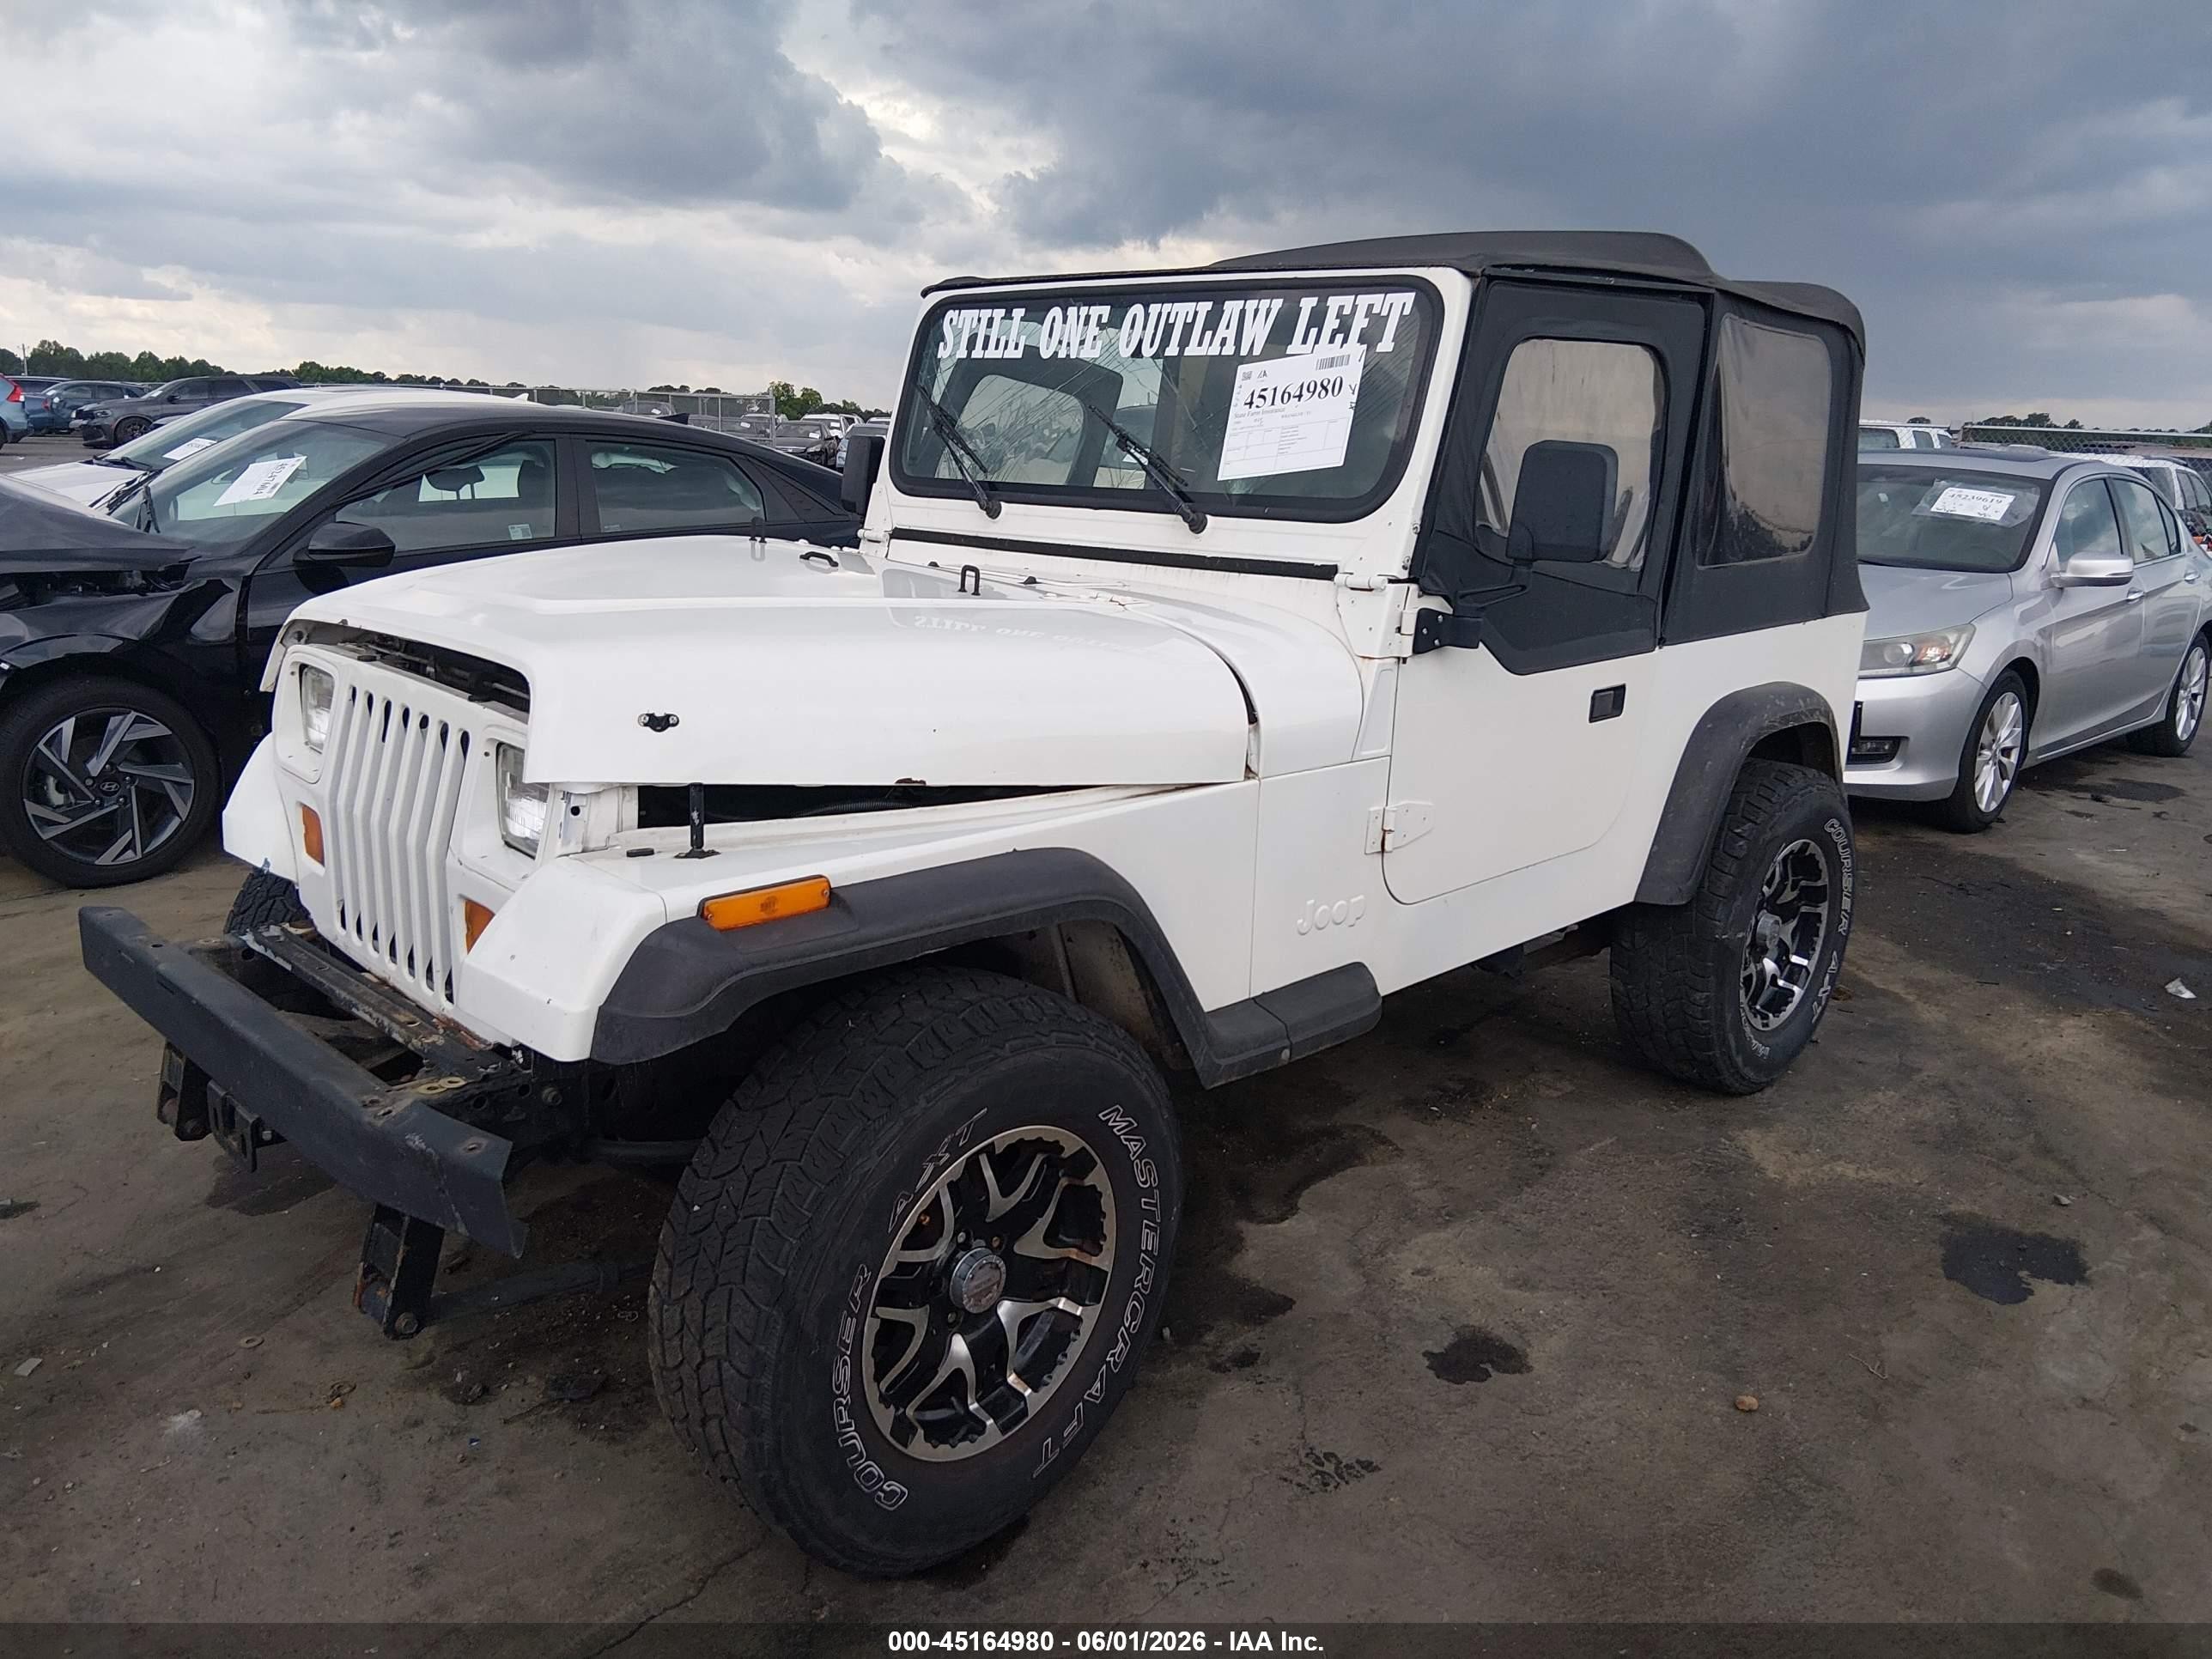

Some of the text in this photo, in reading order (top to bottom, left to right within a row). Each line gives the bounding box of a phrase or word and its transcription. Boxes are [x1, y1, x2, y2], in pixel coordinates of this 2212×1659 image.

[937, 292, 1416, 359] STILL ONE OUTLAW LEFT
[1243, 375, 1344, 410] 45164980
[1824, 818, 1852, 936] COURSER
[1032, 1104, 1161, 1479] MASTERCRAFT
[831, 1263, 908, 1511] COURSER
